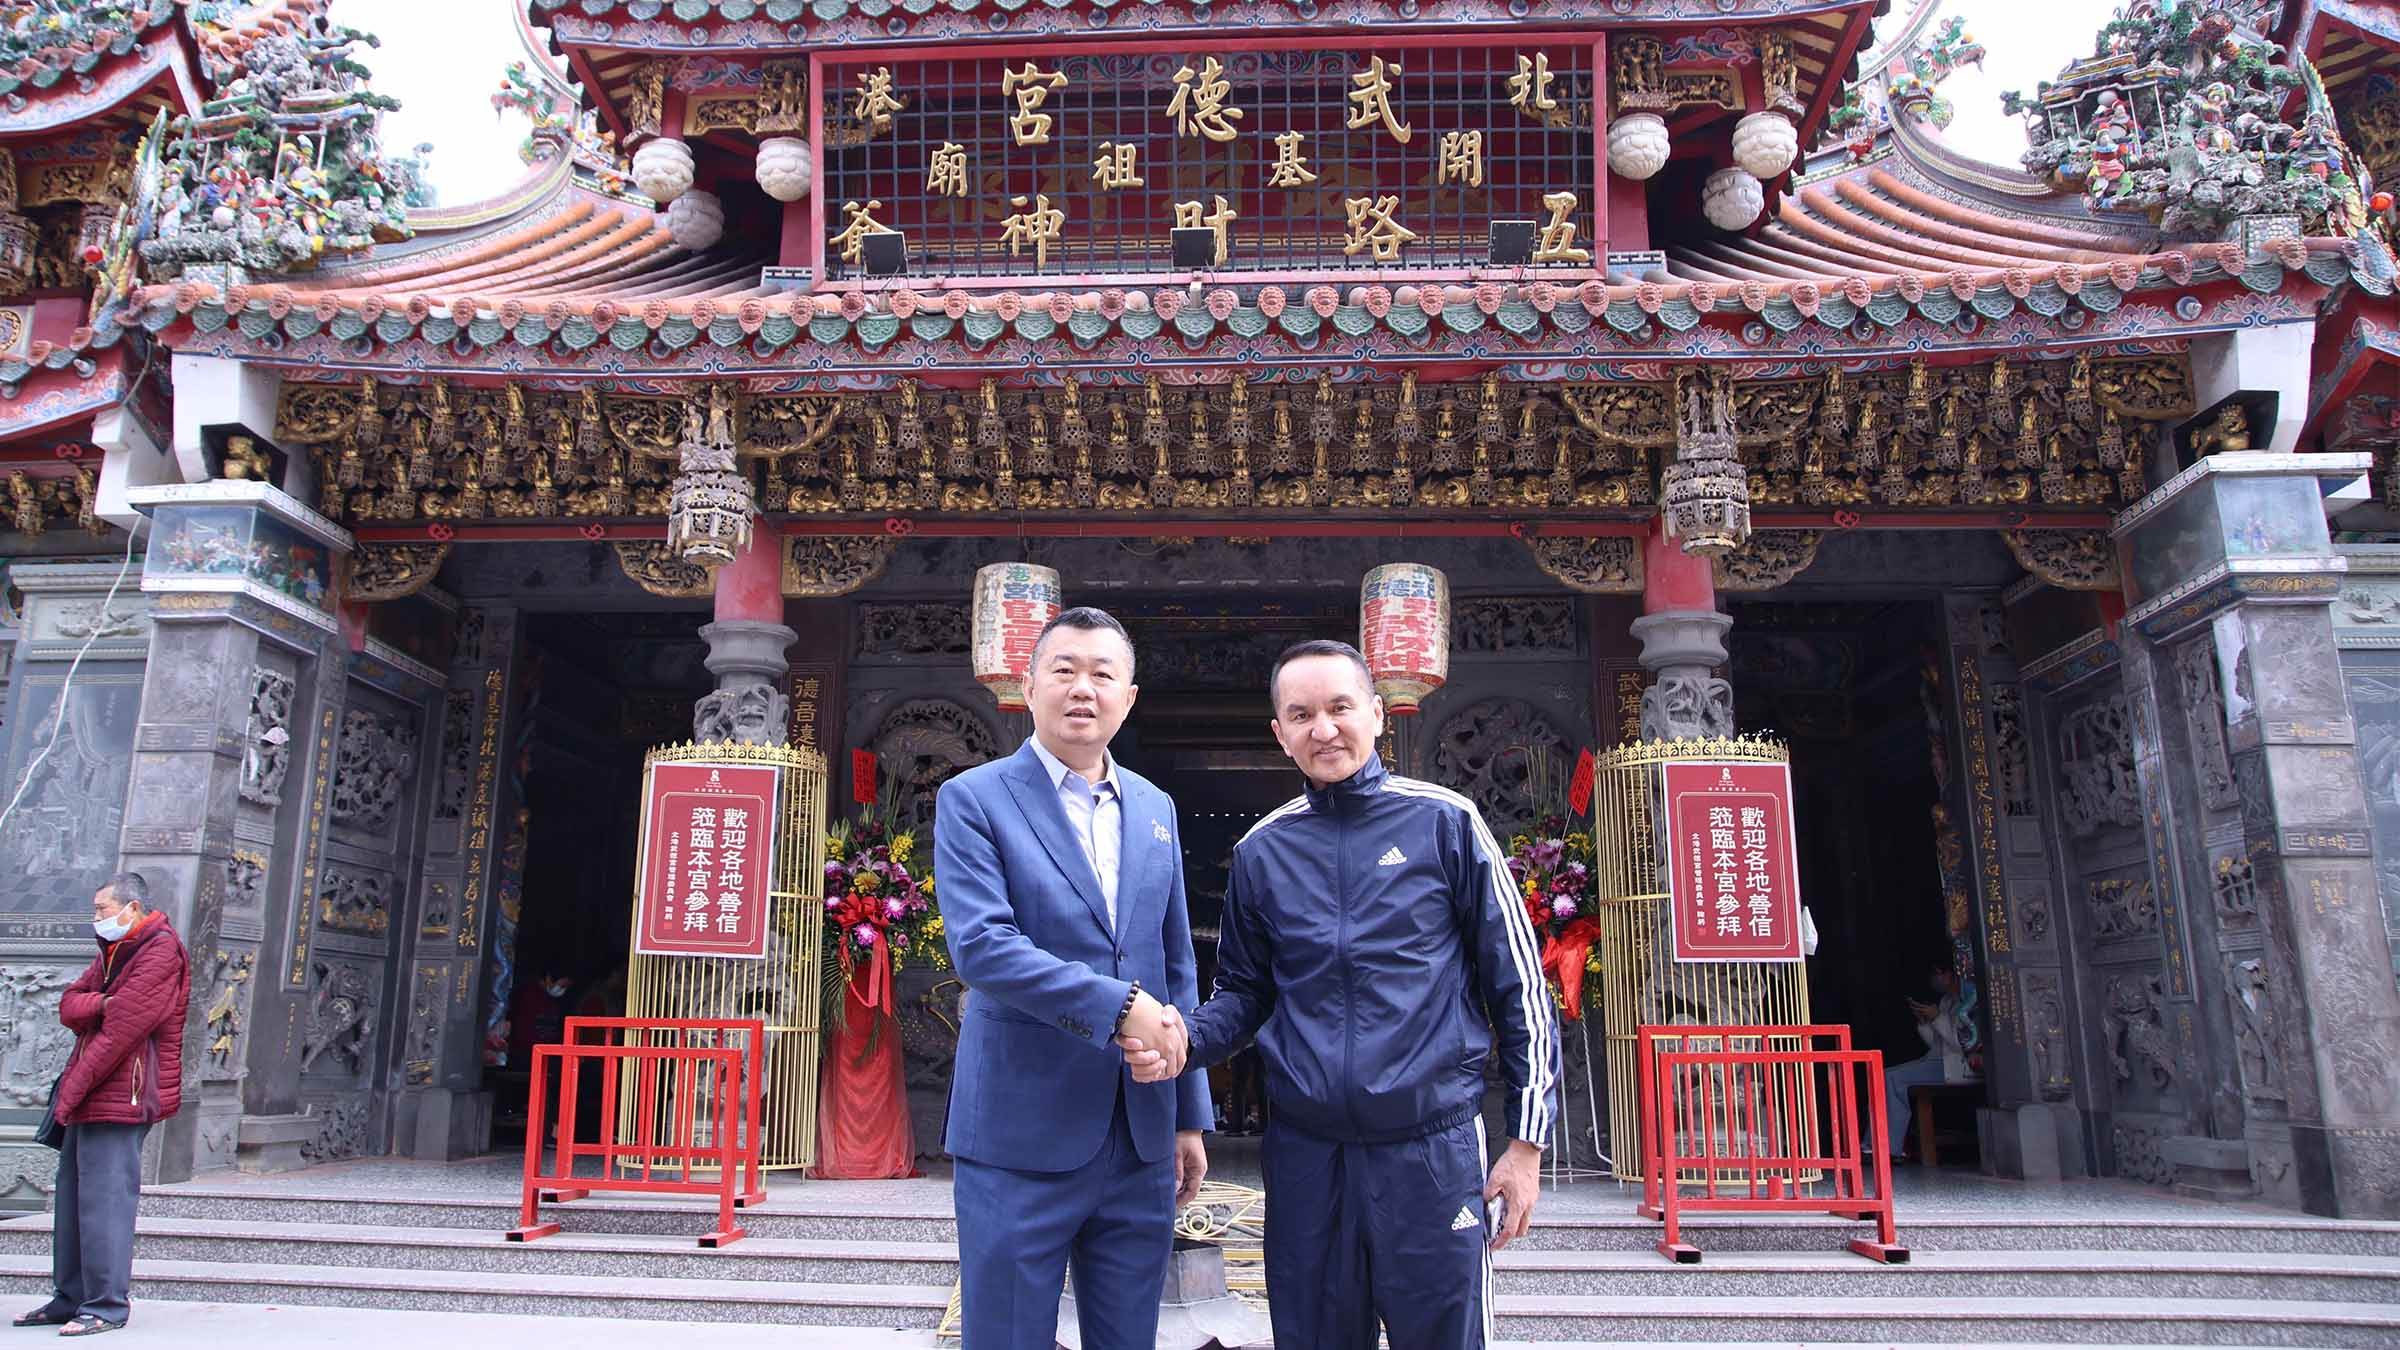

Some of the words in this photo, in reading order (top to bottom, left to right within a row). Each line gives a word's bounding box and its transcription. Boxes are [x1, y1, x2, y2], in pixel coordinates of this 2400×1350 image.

[683, 806, 717, 932] 蒞臨本宮參拜
[715, 807, 748, 934] 歡迎各地善信
[1709, 806, 1743, 937] 蒞臨本宮參拜
[1740, 806, 1773, 937] 歡迎各地善信
